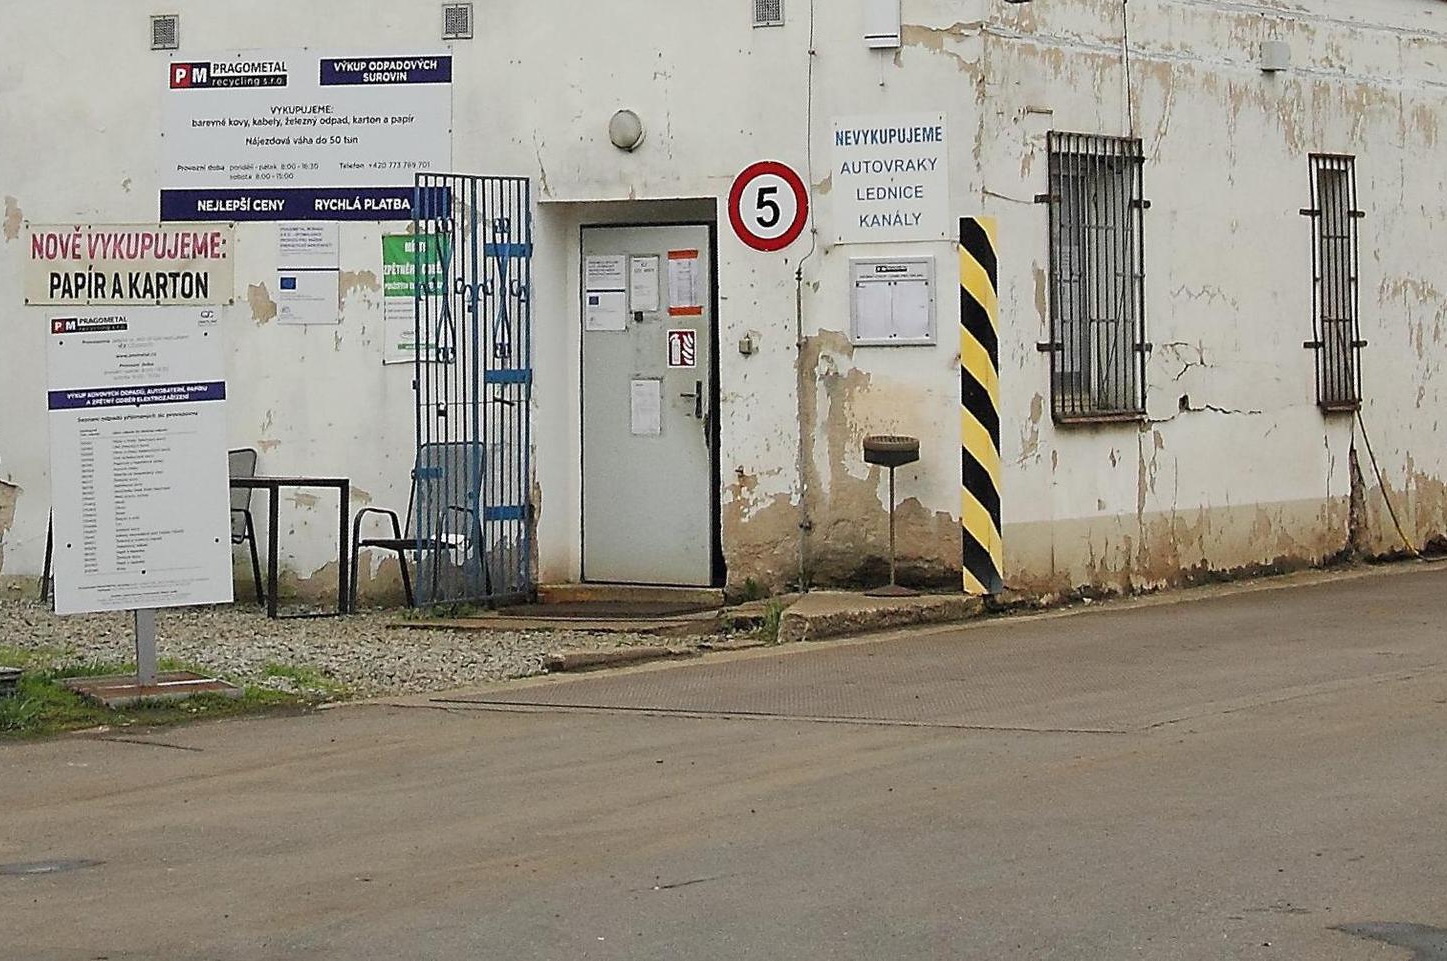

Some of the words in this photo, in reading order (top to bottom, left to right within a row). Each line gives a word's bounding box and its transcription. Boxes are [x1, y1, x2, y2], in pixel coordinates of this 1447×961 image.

[213, 61, 288, 74] PRAGOMETAL
[334, 60, 367, 71] VÝKUP
[368, 58, 437, 71] ODPADOVÝCH
[212, 76, 260, 87] recycling
[363, 71, 407, 82] SUROVIN
[192, 118, 226, 127] barevné
[229, 117, 251, 128] kovy,
[253, 117, 282, 127] kabely,
[353, 115, 382, 124] karton
[391, 114, 415, 125] papír
[246, 136, 291, 147] Nájezdová
[316, 136, 327, 145] do
[330, 136, 341, 144] 50
[835, 126, 943, 146] NEVYKUPUJEME
[841, 157, 937, 175] AUTOVRAKY
[857, 185, 923, 201] LEDNICE
[197, 197, 251, 211] NEJLEPŠÍ
[253, 199, 285, 211] CENY
[314, 196, 361, 211] RYCHLÁ
[364, 198, 411, 210] PLATBA
[756, 186, 781, 228] 5
[859, 209, 921, 228] KANÁLY
[31, 226, 83, 260] NOVĚ
[88, 232, 227, 259] VYKUPUJEME:
[50, 265, 107, 300] PAPÍR
[111, 272, 124, 299] A
[128, 272, 209, 299] KARTON
[79, 316, 128, 324] PRAGOMETAL
